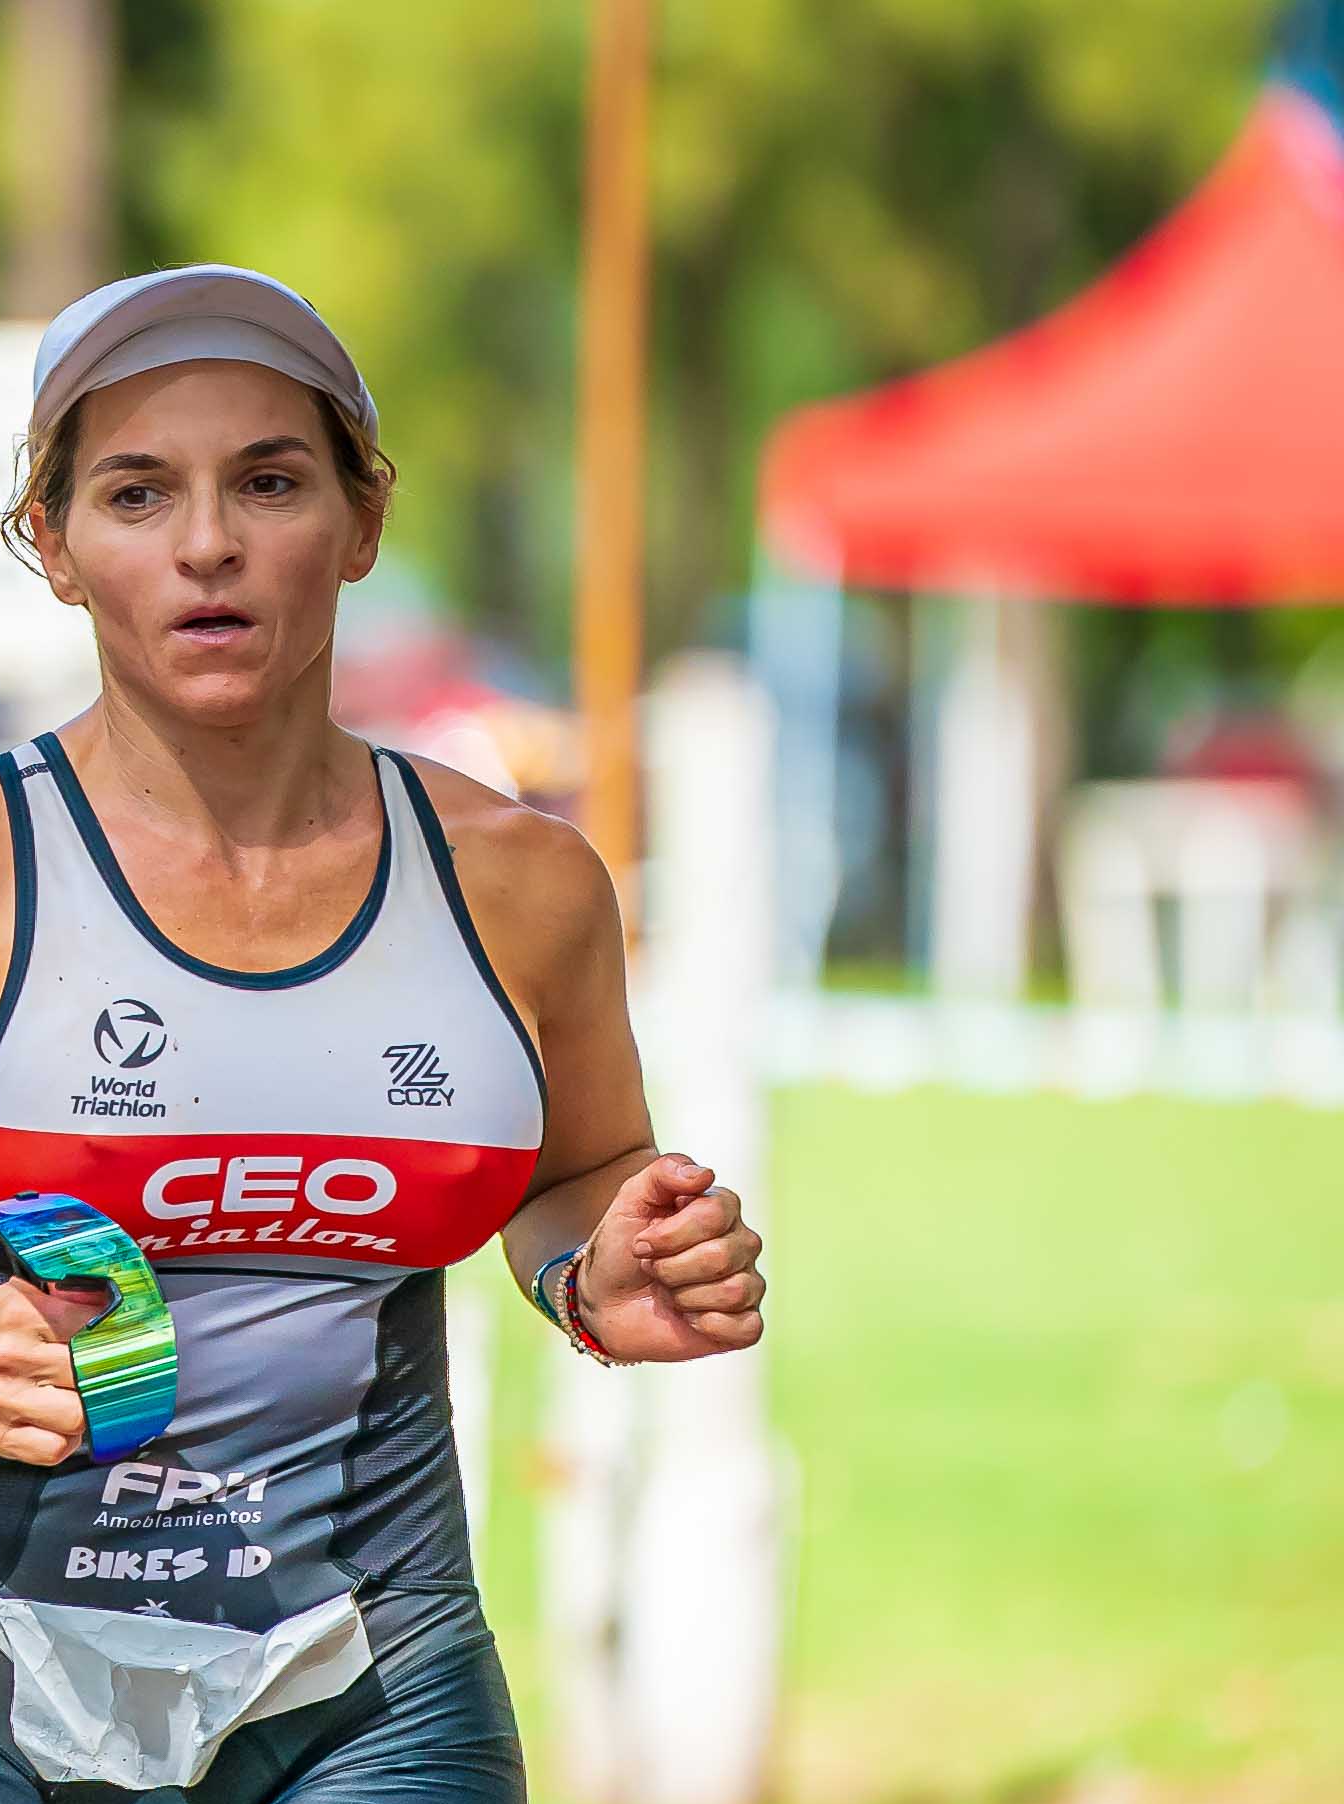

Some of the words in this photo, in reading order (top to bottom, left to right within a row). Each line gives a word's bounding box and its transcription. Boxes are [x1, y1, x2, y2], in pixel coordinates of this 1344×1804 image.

[91, 1075, 157, 1099] World
[387, 1087, 455, 1107] COZY
[70, 1095, 167, 1118] Triathlon
[142, 1156, 398, 1221] CEO
[136, 1218, 398, 1253] riatlon
[64, 1546, 209, 1582] BIKES
[226, 1545, 273, 1578] ID
